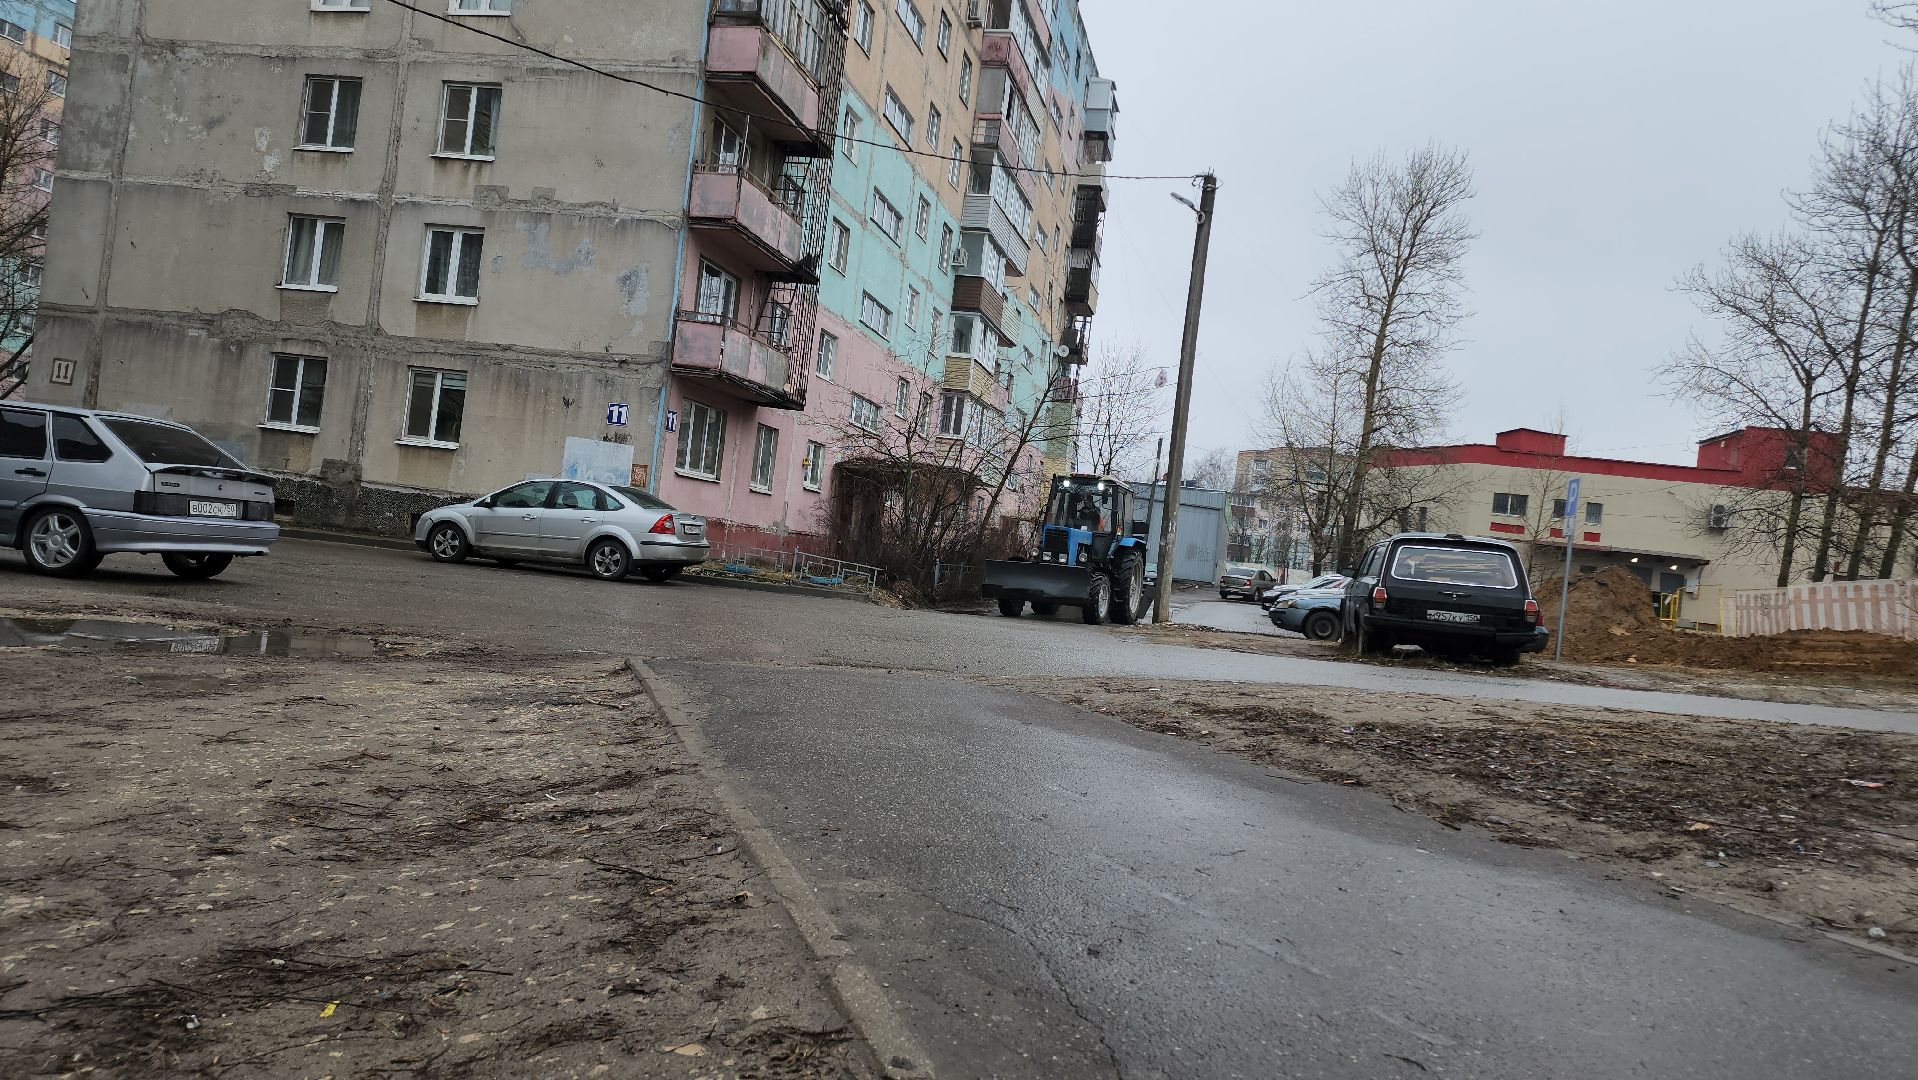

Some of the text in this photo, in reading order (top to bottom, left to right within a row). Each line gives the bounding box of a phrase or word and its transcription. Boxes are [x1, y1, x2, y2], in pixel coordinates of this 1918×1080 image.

[56, 362, 70, 379] 11
[609, 405, 627, 423] 11
[667, 412, 677, 430] 11
[1567, 482, 1578, 513] P
